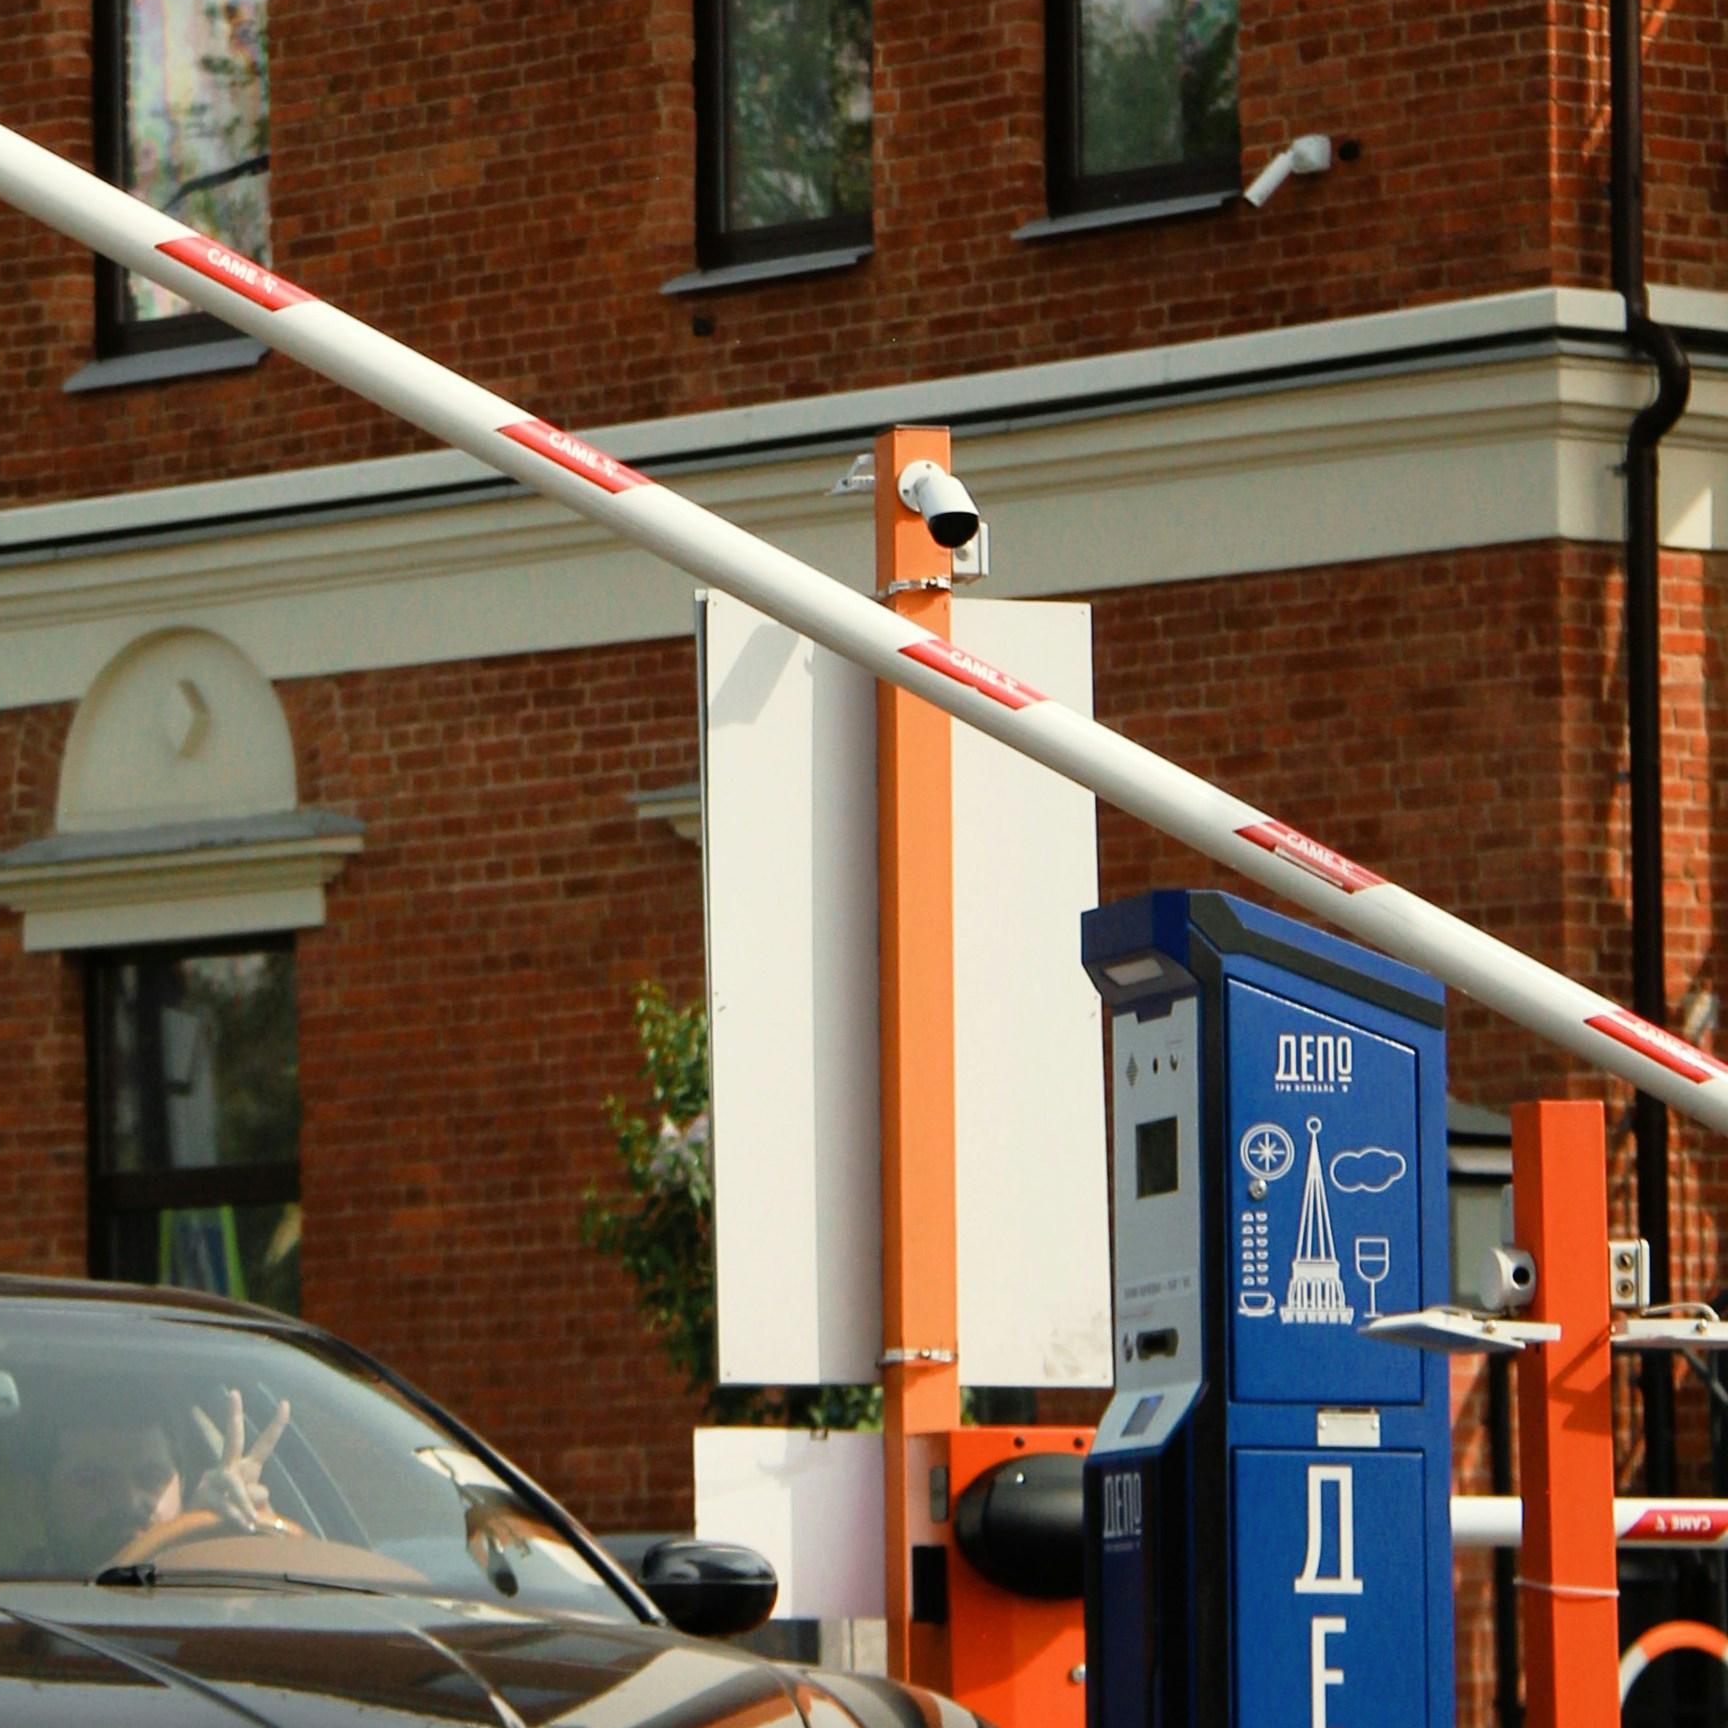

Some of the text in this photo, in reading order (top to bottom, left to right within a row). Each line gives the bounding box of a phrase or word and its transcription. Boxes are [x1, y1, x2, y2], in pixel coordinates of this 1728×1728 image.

[207, 247, 258, 285] CAME
[549, 432, 598, 469] CAME
[950, 649, 998, 686] CAME
[1286, 832, 1335, 869] CAME
[1275, 1035, 1352, 1082] ДЕПО
[1103, 1472, 1142, 1538] ДЕПО
